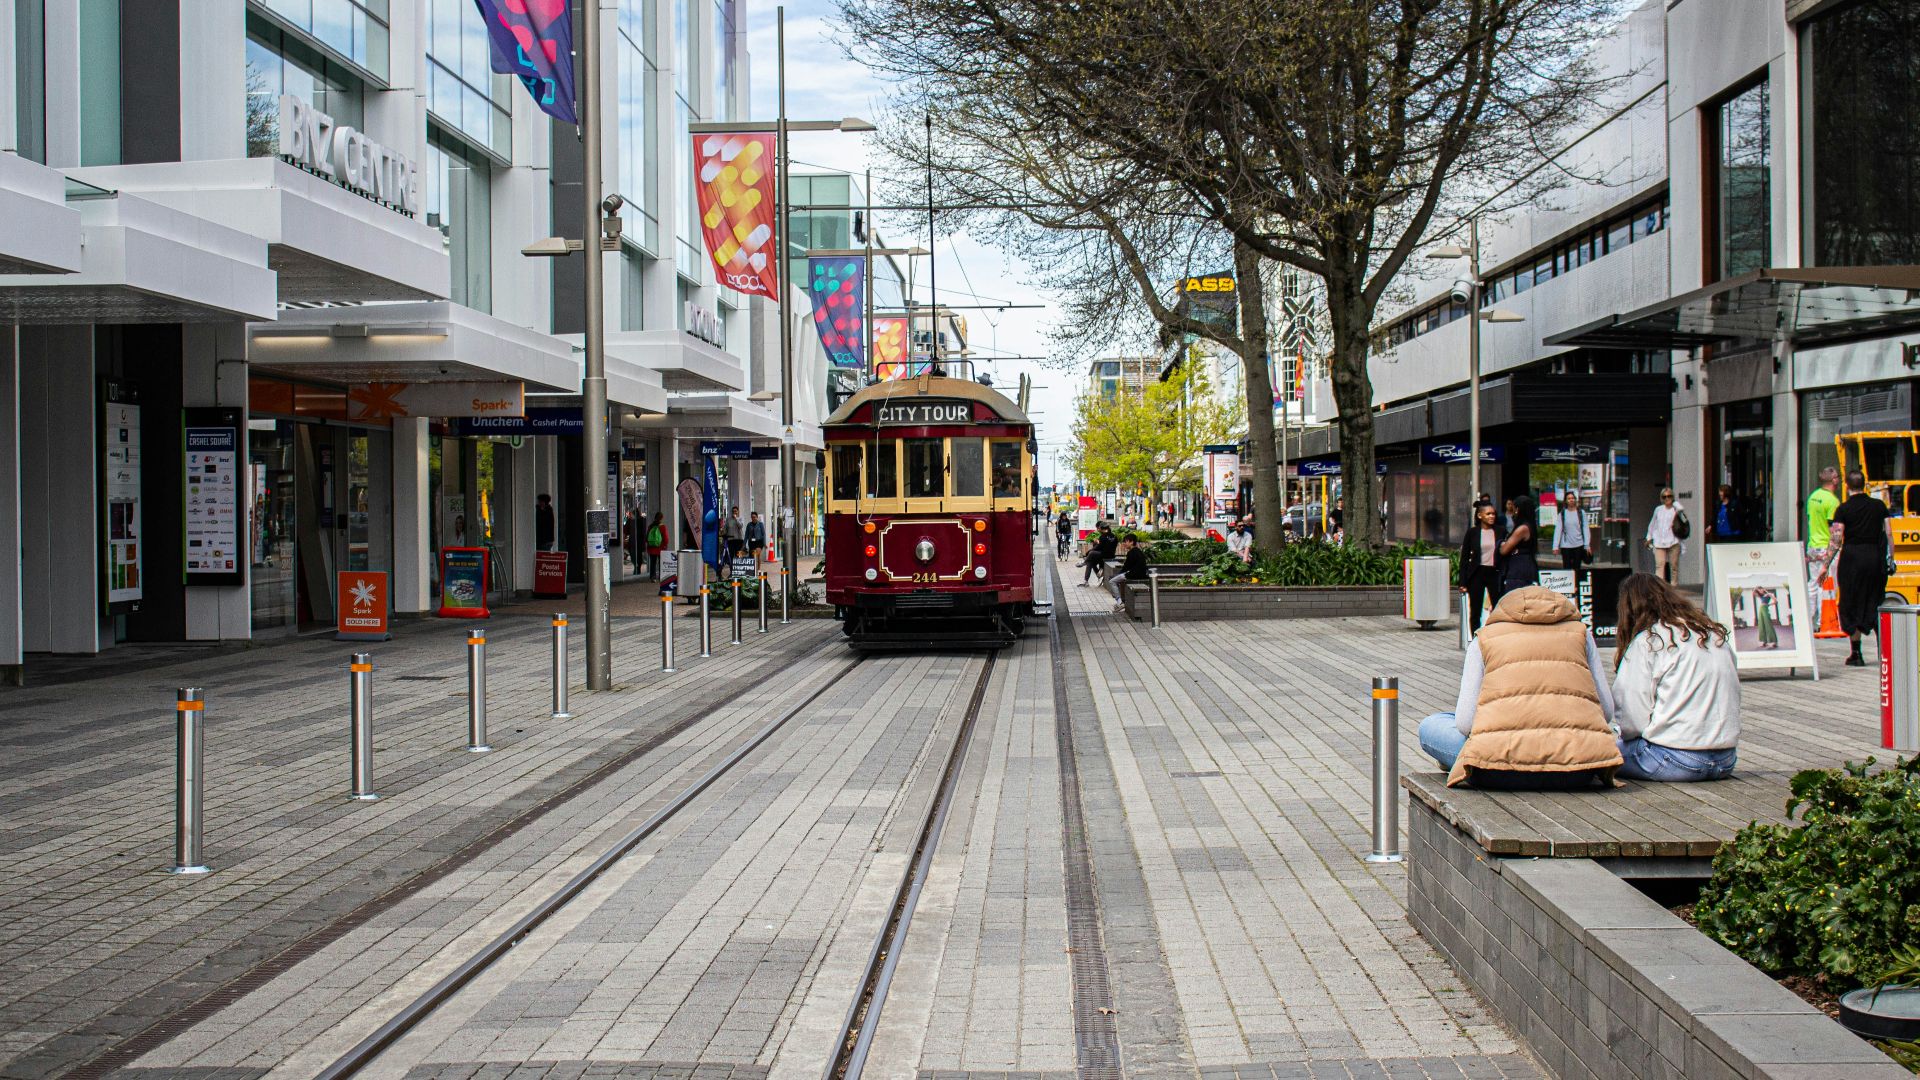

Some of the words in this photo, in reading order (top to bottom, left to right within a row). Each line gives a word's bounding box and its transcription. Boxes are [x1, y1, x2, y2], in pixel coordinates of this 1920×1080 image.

[279, 95, 334, 176] BNZ
[333, 126, 417, 214] CENTRE
[472, 398, 507, 413] Spark
[879, 406, 917, 421] CITY
[921, 405, 969, 421] TOUR
[471, 416, 524, 427] Unichem
[702, 445, 718, 454] bnz
[541, 563, 560, 571] Postal
[538, 569, 563, 577] Services
[913, 572, 938, 583] 244
[352, 607, 372, 615] Spark
[1880, 653, 1889, 707] Litter
